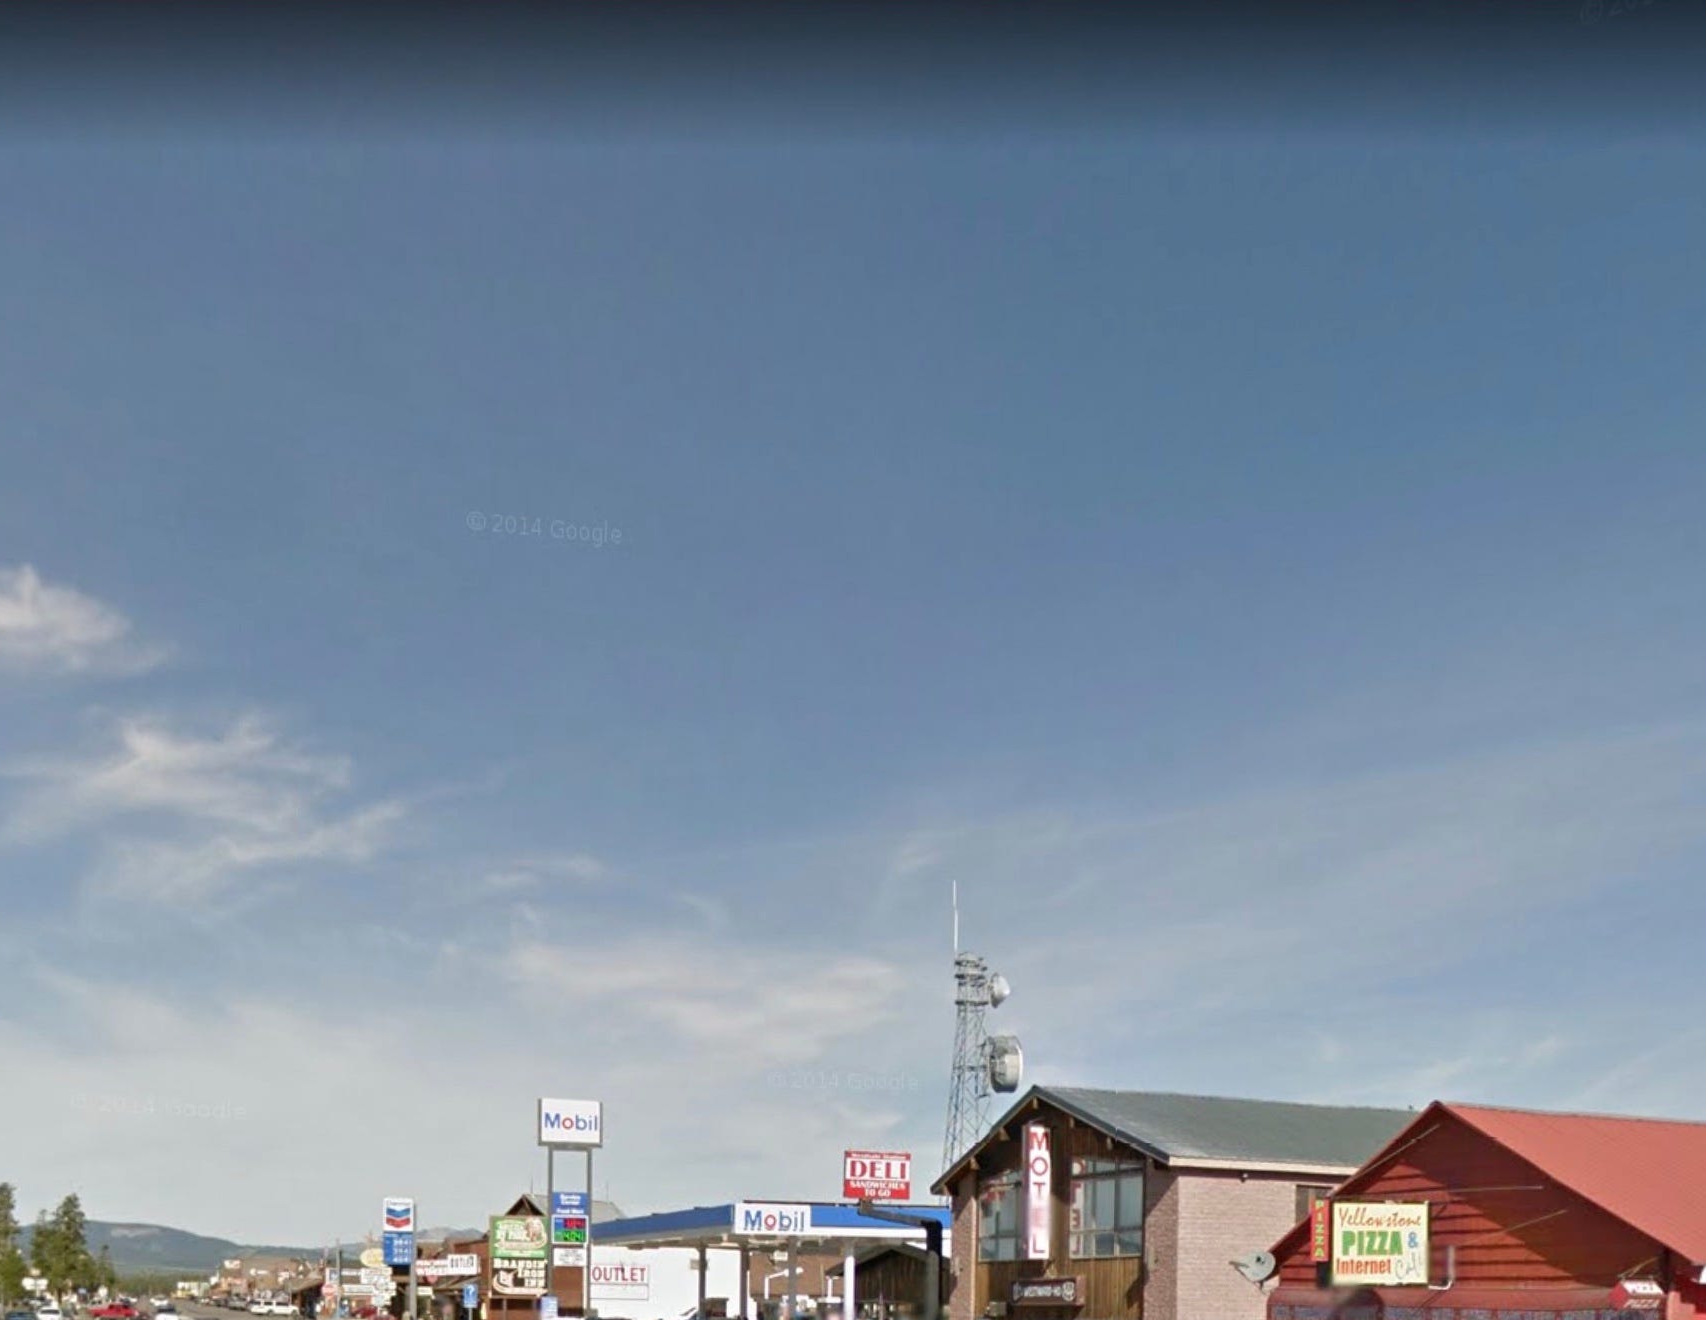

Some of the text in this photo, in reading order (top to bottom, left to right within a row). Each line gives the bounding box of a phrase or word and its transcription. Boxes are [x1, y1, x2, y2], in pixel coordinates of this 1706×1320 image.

[544, 1111, 598, 1132] Mobil
[849, 1160, 907, 1180] DELI
[864, 1188, 891, 1198] TO GO
[1029, 1131, 1050, 1255] MOTEL
[744, 1209, 806, 1232] Mobil
[1338, 1206, 1422, 1227] Yellowstone
[1314, 1199, 1325, 1258] PIZZA
[1341, 1230, 1419, 1256] PIZZA &
[591, 1266, 647, 1282] OUTLET
[1336, 1257, 1392, 1275] Internet
